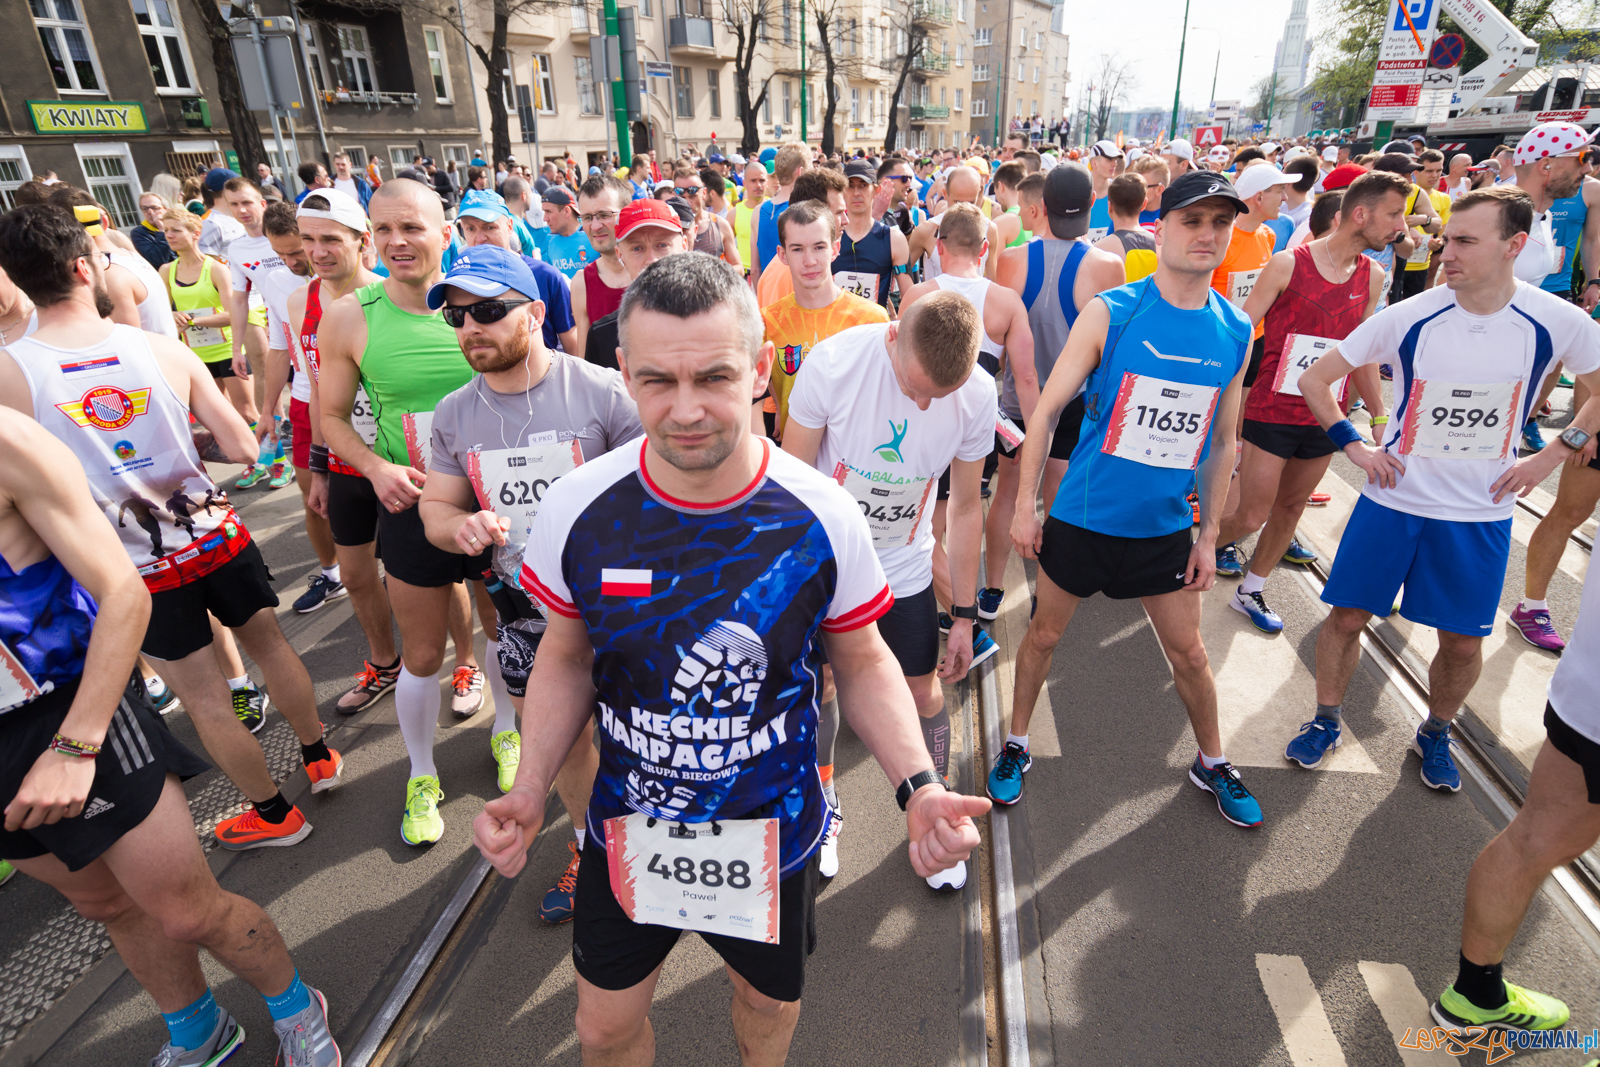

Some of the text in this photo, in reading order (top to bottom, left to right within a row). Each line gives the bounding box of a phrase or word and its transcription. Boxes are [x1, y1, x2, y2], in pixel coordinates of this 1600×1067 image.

[1379, 60, 1416, 69] Podstrefa
[1460, 84, 1484, 92] Steiger
[47, 107, 129, 128] KWIATY
[1199, 128, 1218, 144] A
[552, 258, 577, 270] KUBA
[93, 389, 112, 397] 1919
[90, 415, 117, 428] ŚRODA
[1137, 405, 1202, 435] 11635
[1431, 406, 1500, 428] 9596
[1148, 433, 1179, 444] Wojciech
[499, 476, 562, 506] 620
[631, 706, 751, 742] KĘCKIE
[598, 701, 790, 770] HARPAGANY
[641, 760, 740, 782] GRUPA BIEGOWA
[84, 802, 116, 820] adidas
[647, 853, 752, 890] 4888
[682, 890, 717, 902] Paweł
